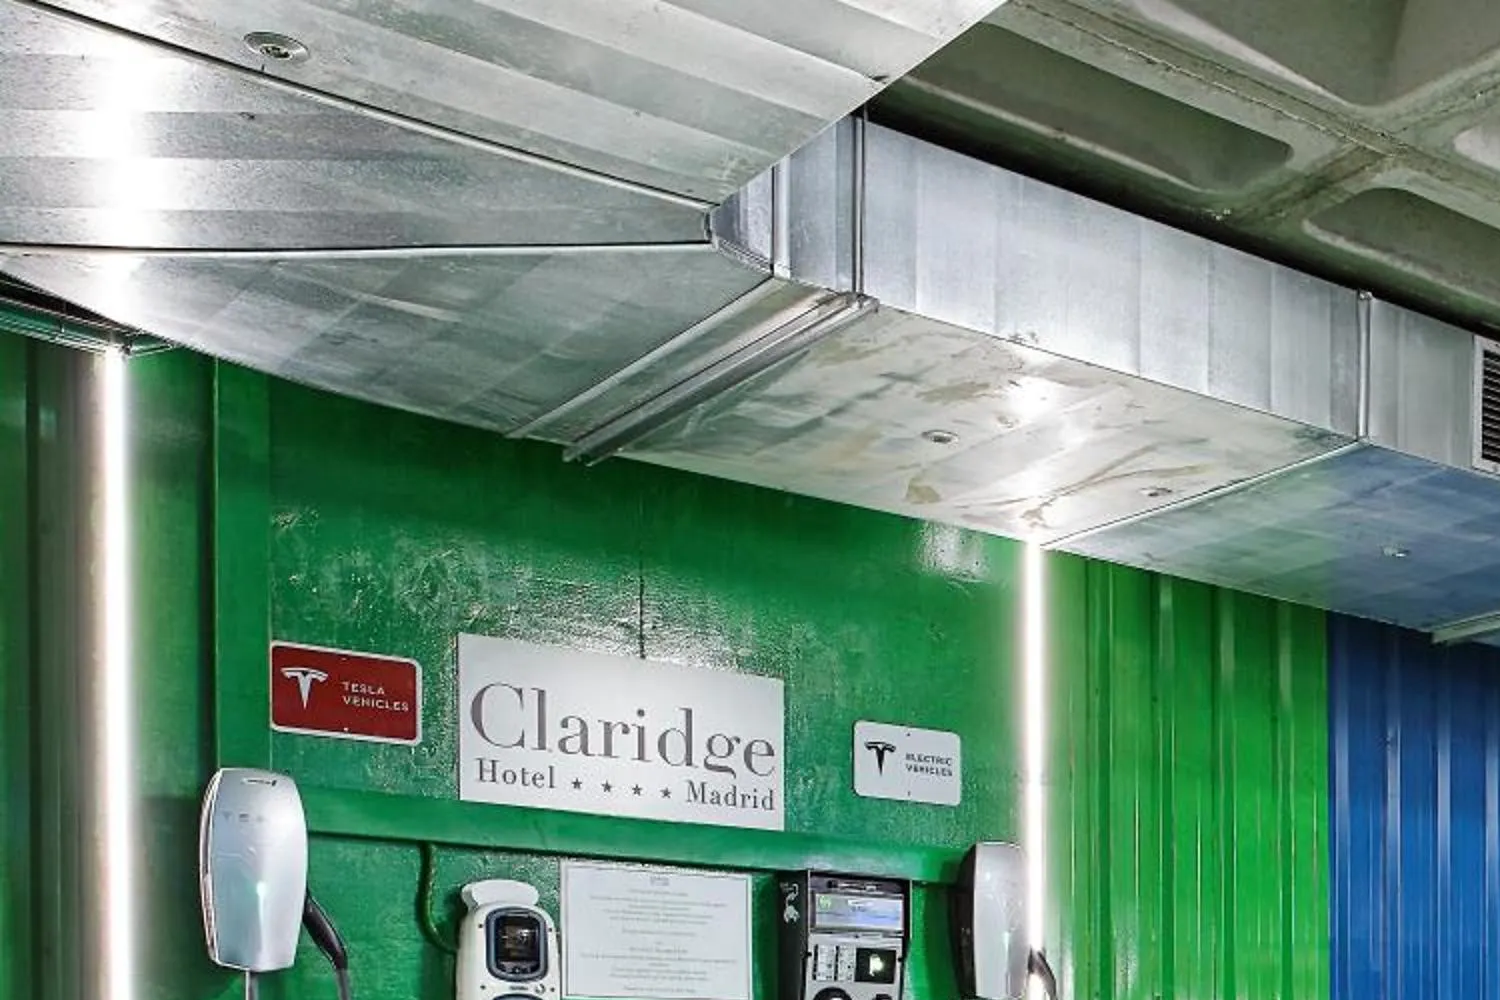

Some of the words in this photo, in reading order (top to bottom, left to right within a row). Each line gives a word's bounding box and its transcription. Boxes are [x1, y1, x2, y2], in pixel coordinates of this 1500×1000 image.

[341, 681, 386, 696] TESLA
[341, 695, 410, 712] VEHICLES
[470, 681, 776, 779] Claridge
[905, 752, 953, 767] ELECTRIC
[905, 763, 954, 777] VEHICLES
[475, 757, 557, 790] Hotel
[686, 779, 775, 811] Madrid
